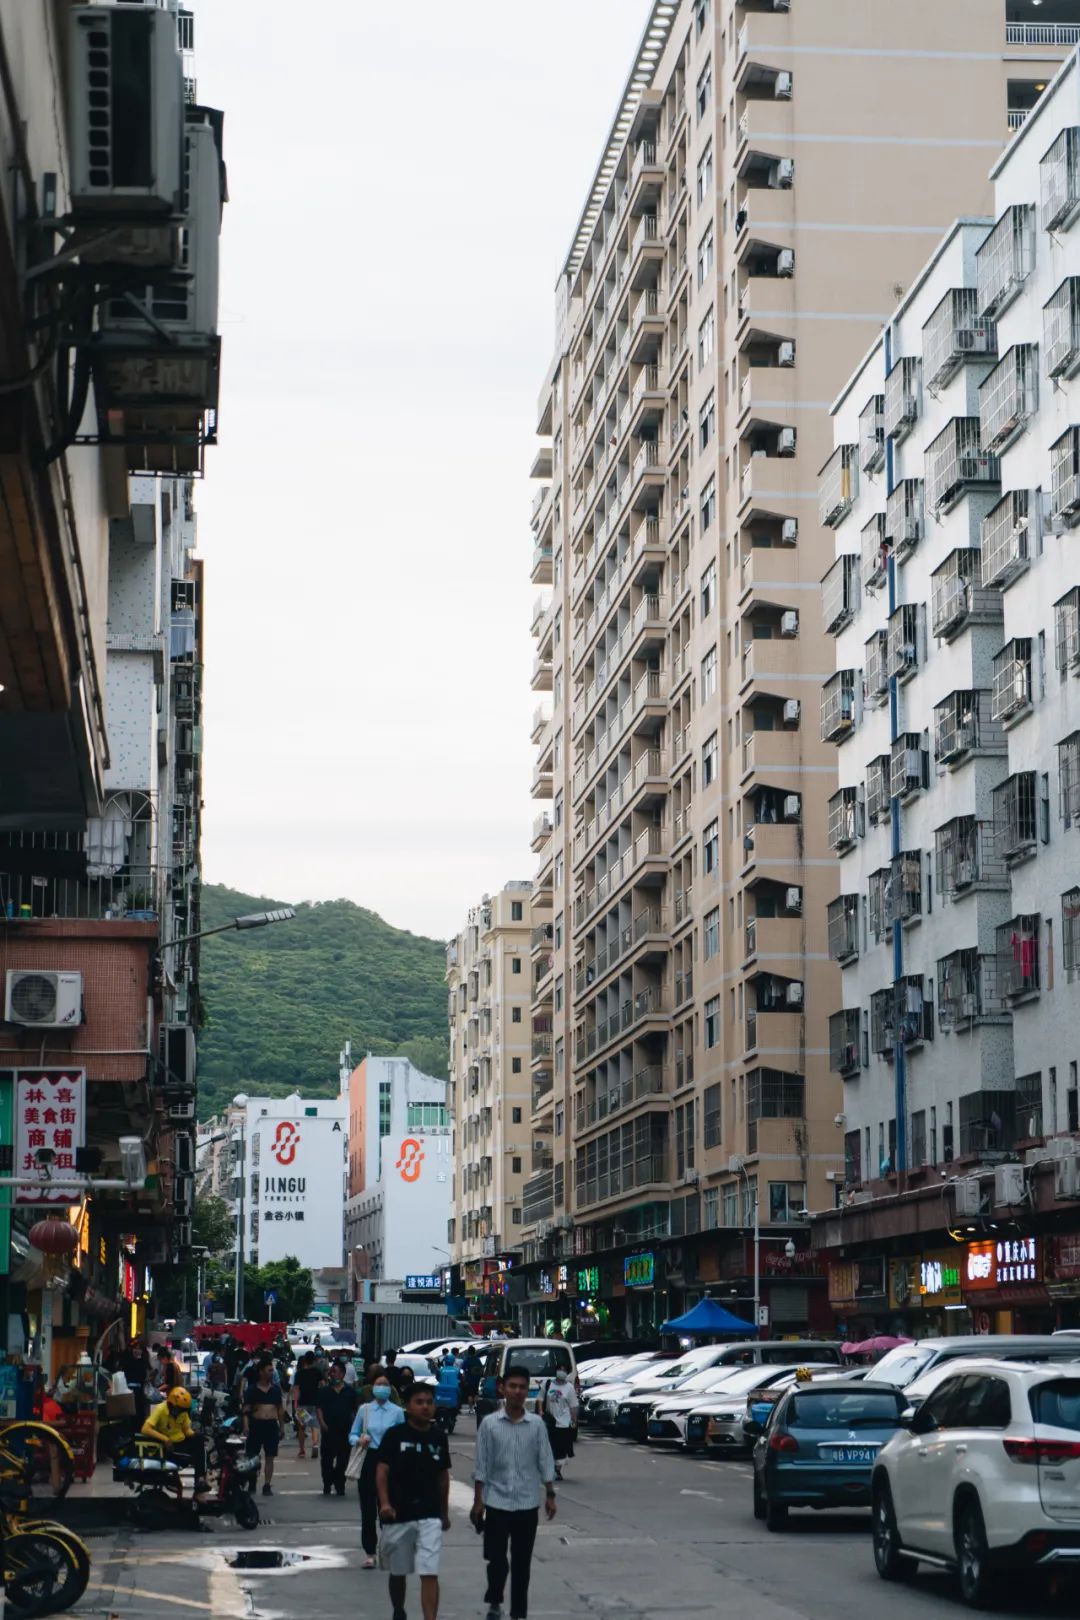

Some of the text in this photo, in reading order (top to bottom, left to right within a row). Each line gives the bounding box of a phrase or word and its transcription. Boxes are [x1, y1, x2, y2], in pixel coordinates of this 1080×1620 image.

[24, 1107, 76, 1124] 美食街
[332, 1121, 341, 1131] A
[28, 1128, 72, 1148] 商铺
[265, 1177, 306, 1193] JINGU
[264, 1211, 305, 1221] 金谷小镇
